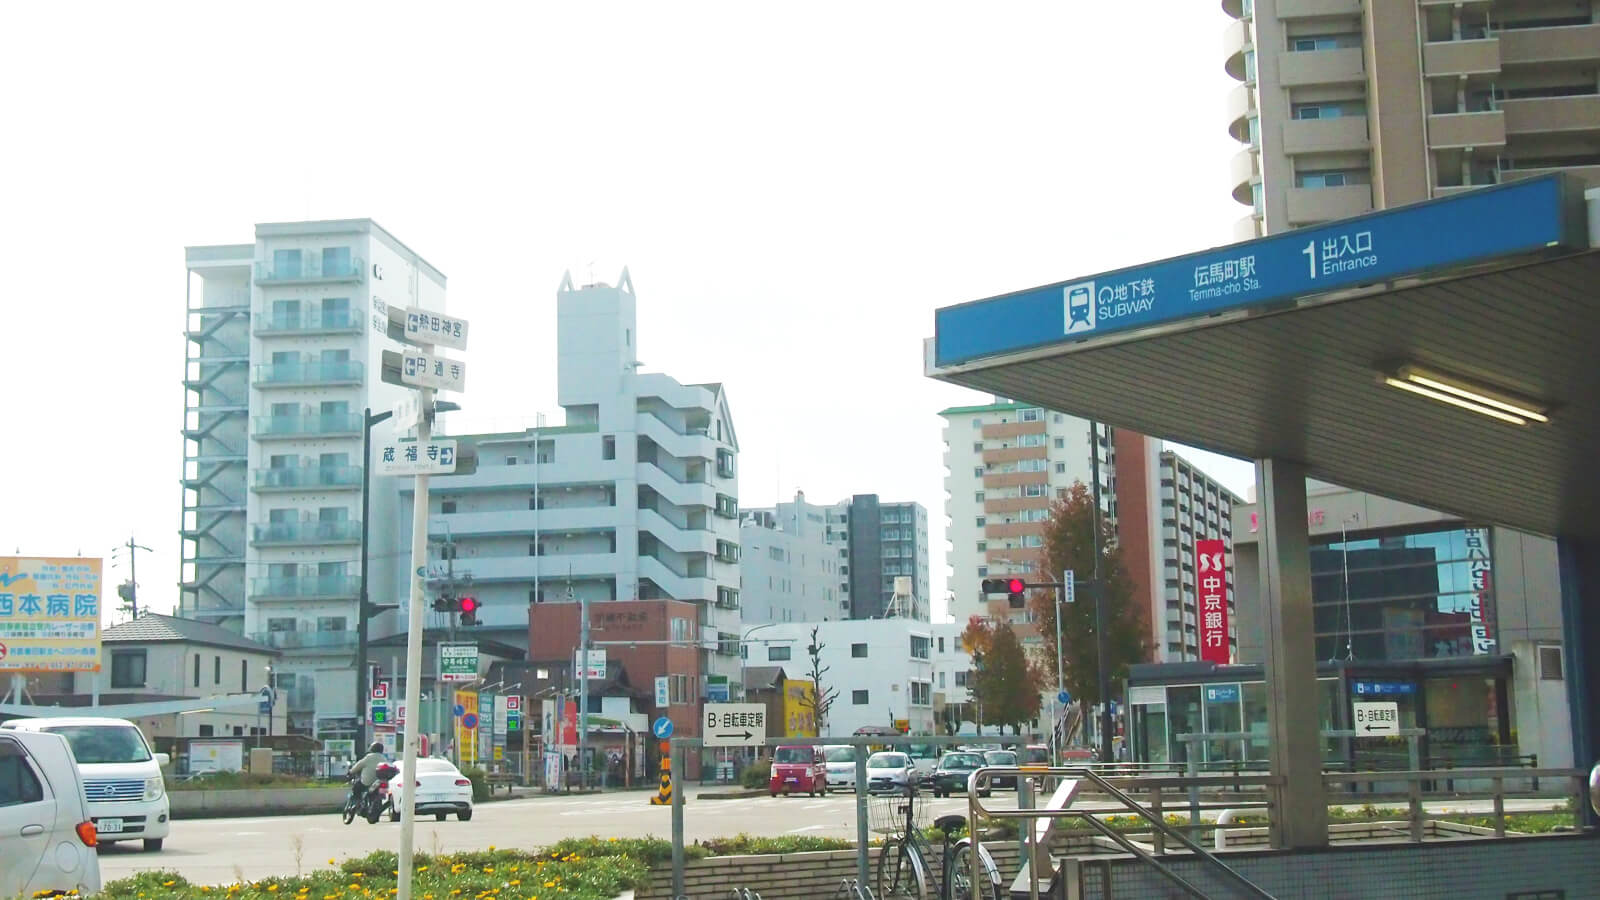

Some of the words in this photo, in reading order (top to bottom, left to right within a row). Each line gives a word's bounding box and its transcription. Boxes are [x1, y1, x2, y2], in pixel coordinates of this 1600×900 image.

[1322, 231, 1373, 260] 出入口
[1194, 255, 1257, 288] 伝馬町駅
[1302, 240, 1316, 280] 1
[1323, 253, 1378, 276] Entrance
[1114, 278, 1156, 302] 地下鉄
[1188, 283, 1241, 302] Temma-cho
[1243, 280, 1262, 294] Sta.
[1098, 297, 1154, 321] SUBWAY
[418, 312, 463, 338] 熱田神宮
[1203, 575, 1224, 648] 中京銀行
